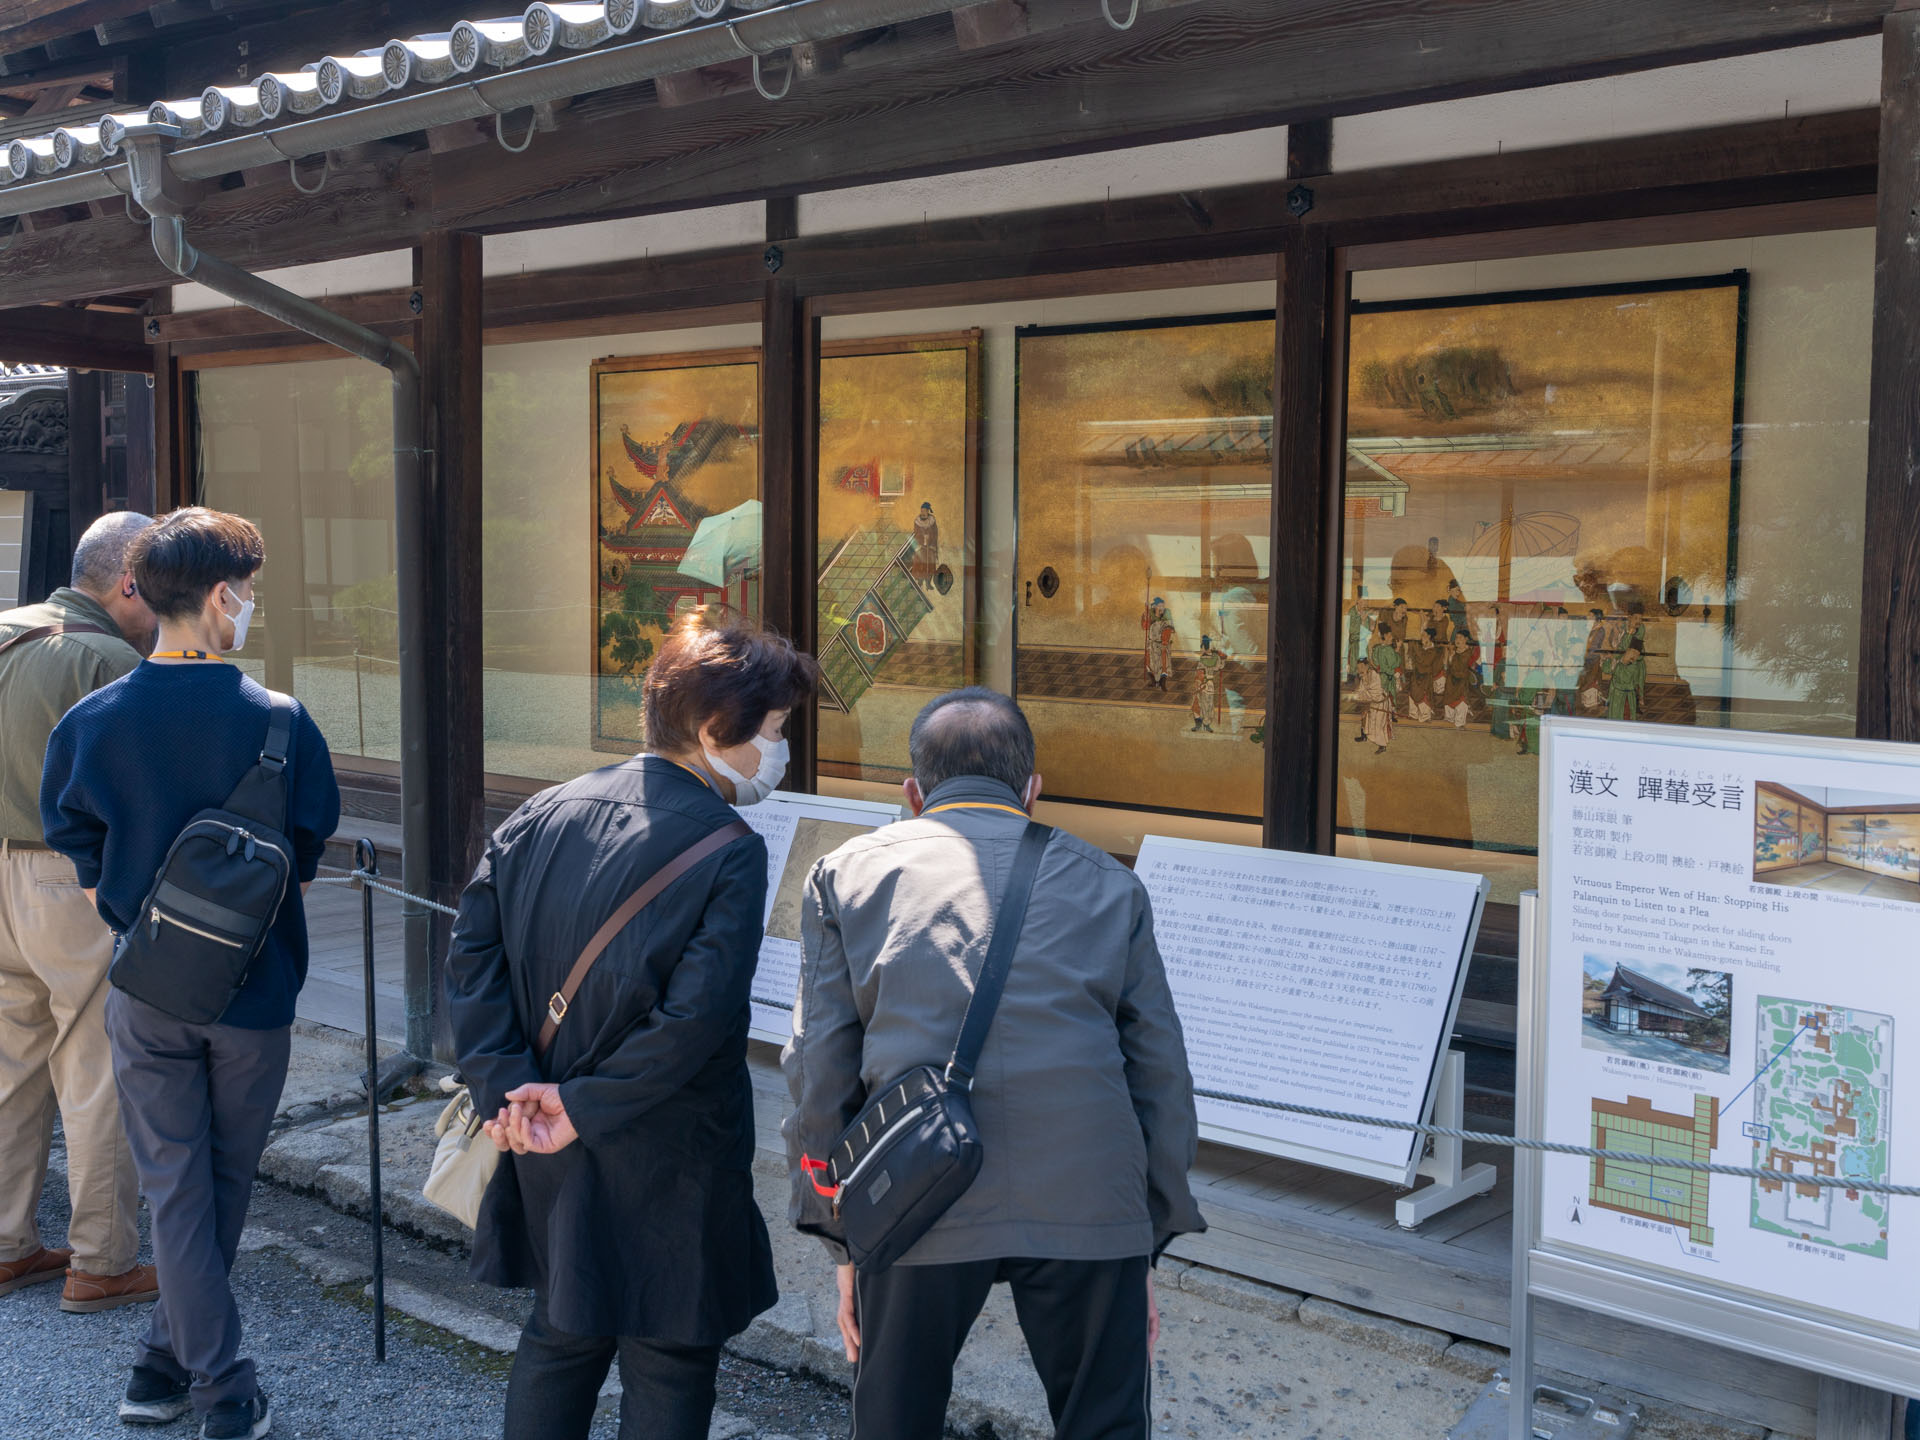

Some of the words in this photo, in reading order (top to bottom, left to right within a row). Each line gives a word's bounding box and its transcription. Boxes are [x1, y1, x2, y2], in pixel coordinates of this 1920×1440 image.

[1569, 769, 1618, 798] 漢文
[1638, 776, 1744, 810] 蹕輦受言
[1573, 875, 1613, 889] Virtuous
[1615, 880, 1656, 895] Emperor
[1658, 886, 1681, 898] Wen
[1683, 890, 1695, 900] of
[1697, 891, 1721, 904] Han:
[1724, 895, 1769, 912] Stopping
[1772, 901, 1790, 913] His
[1573, 890, 1619, 905] Palanquin
[1621, 898, 1632, 907] to
[1634, 898, 1664, 911] Listen
[1666, 904, 1677, 913] to
[1679, 907, 1686, 915] a
[1689, 905, 1710, 918] Plea
[1572, 905, 1600, 918] Sliding
[1601, 909, 1621, 919] door
[1622, 914, 1649, 923] panels
[1650, 917, 1666, 926] and
[1668, 918, 1690, 929] Door
[1692, 924, 1720, 933] pocket
[1722, 927, 1735, 935] for
[1737, 928, 1766, 942] sliding
[1768, 932, 1792, 943] doors
[1572, 918, 1603, 931] Painted
[1604, 923, 1614, 934] by
[1617, 925, 1660, 939] Katsuyama
[1664, 931, 1699, 945] Takugan
[1712, 939, 1726, 948] the
[1729, 941, 1757, 953] Kansei
[1760, 945, 1775, 956] Era
[1624, 942, 1646, 951] room
[1647, 943, 1656, 953] in
[1658, 945, 1672, 954] the
[1674, 947, 1743, 965] Wakamiya-goten
[1746, 960, 1781, 973] building
[1573, 1196, 1580, 1204] N
